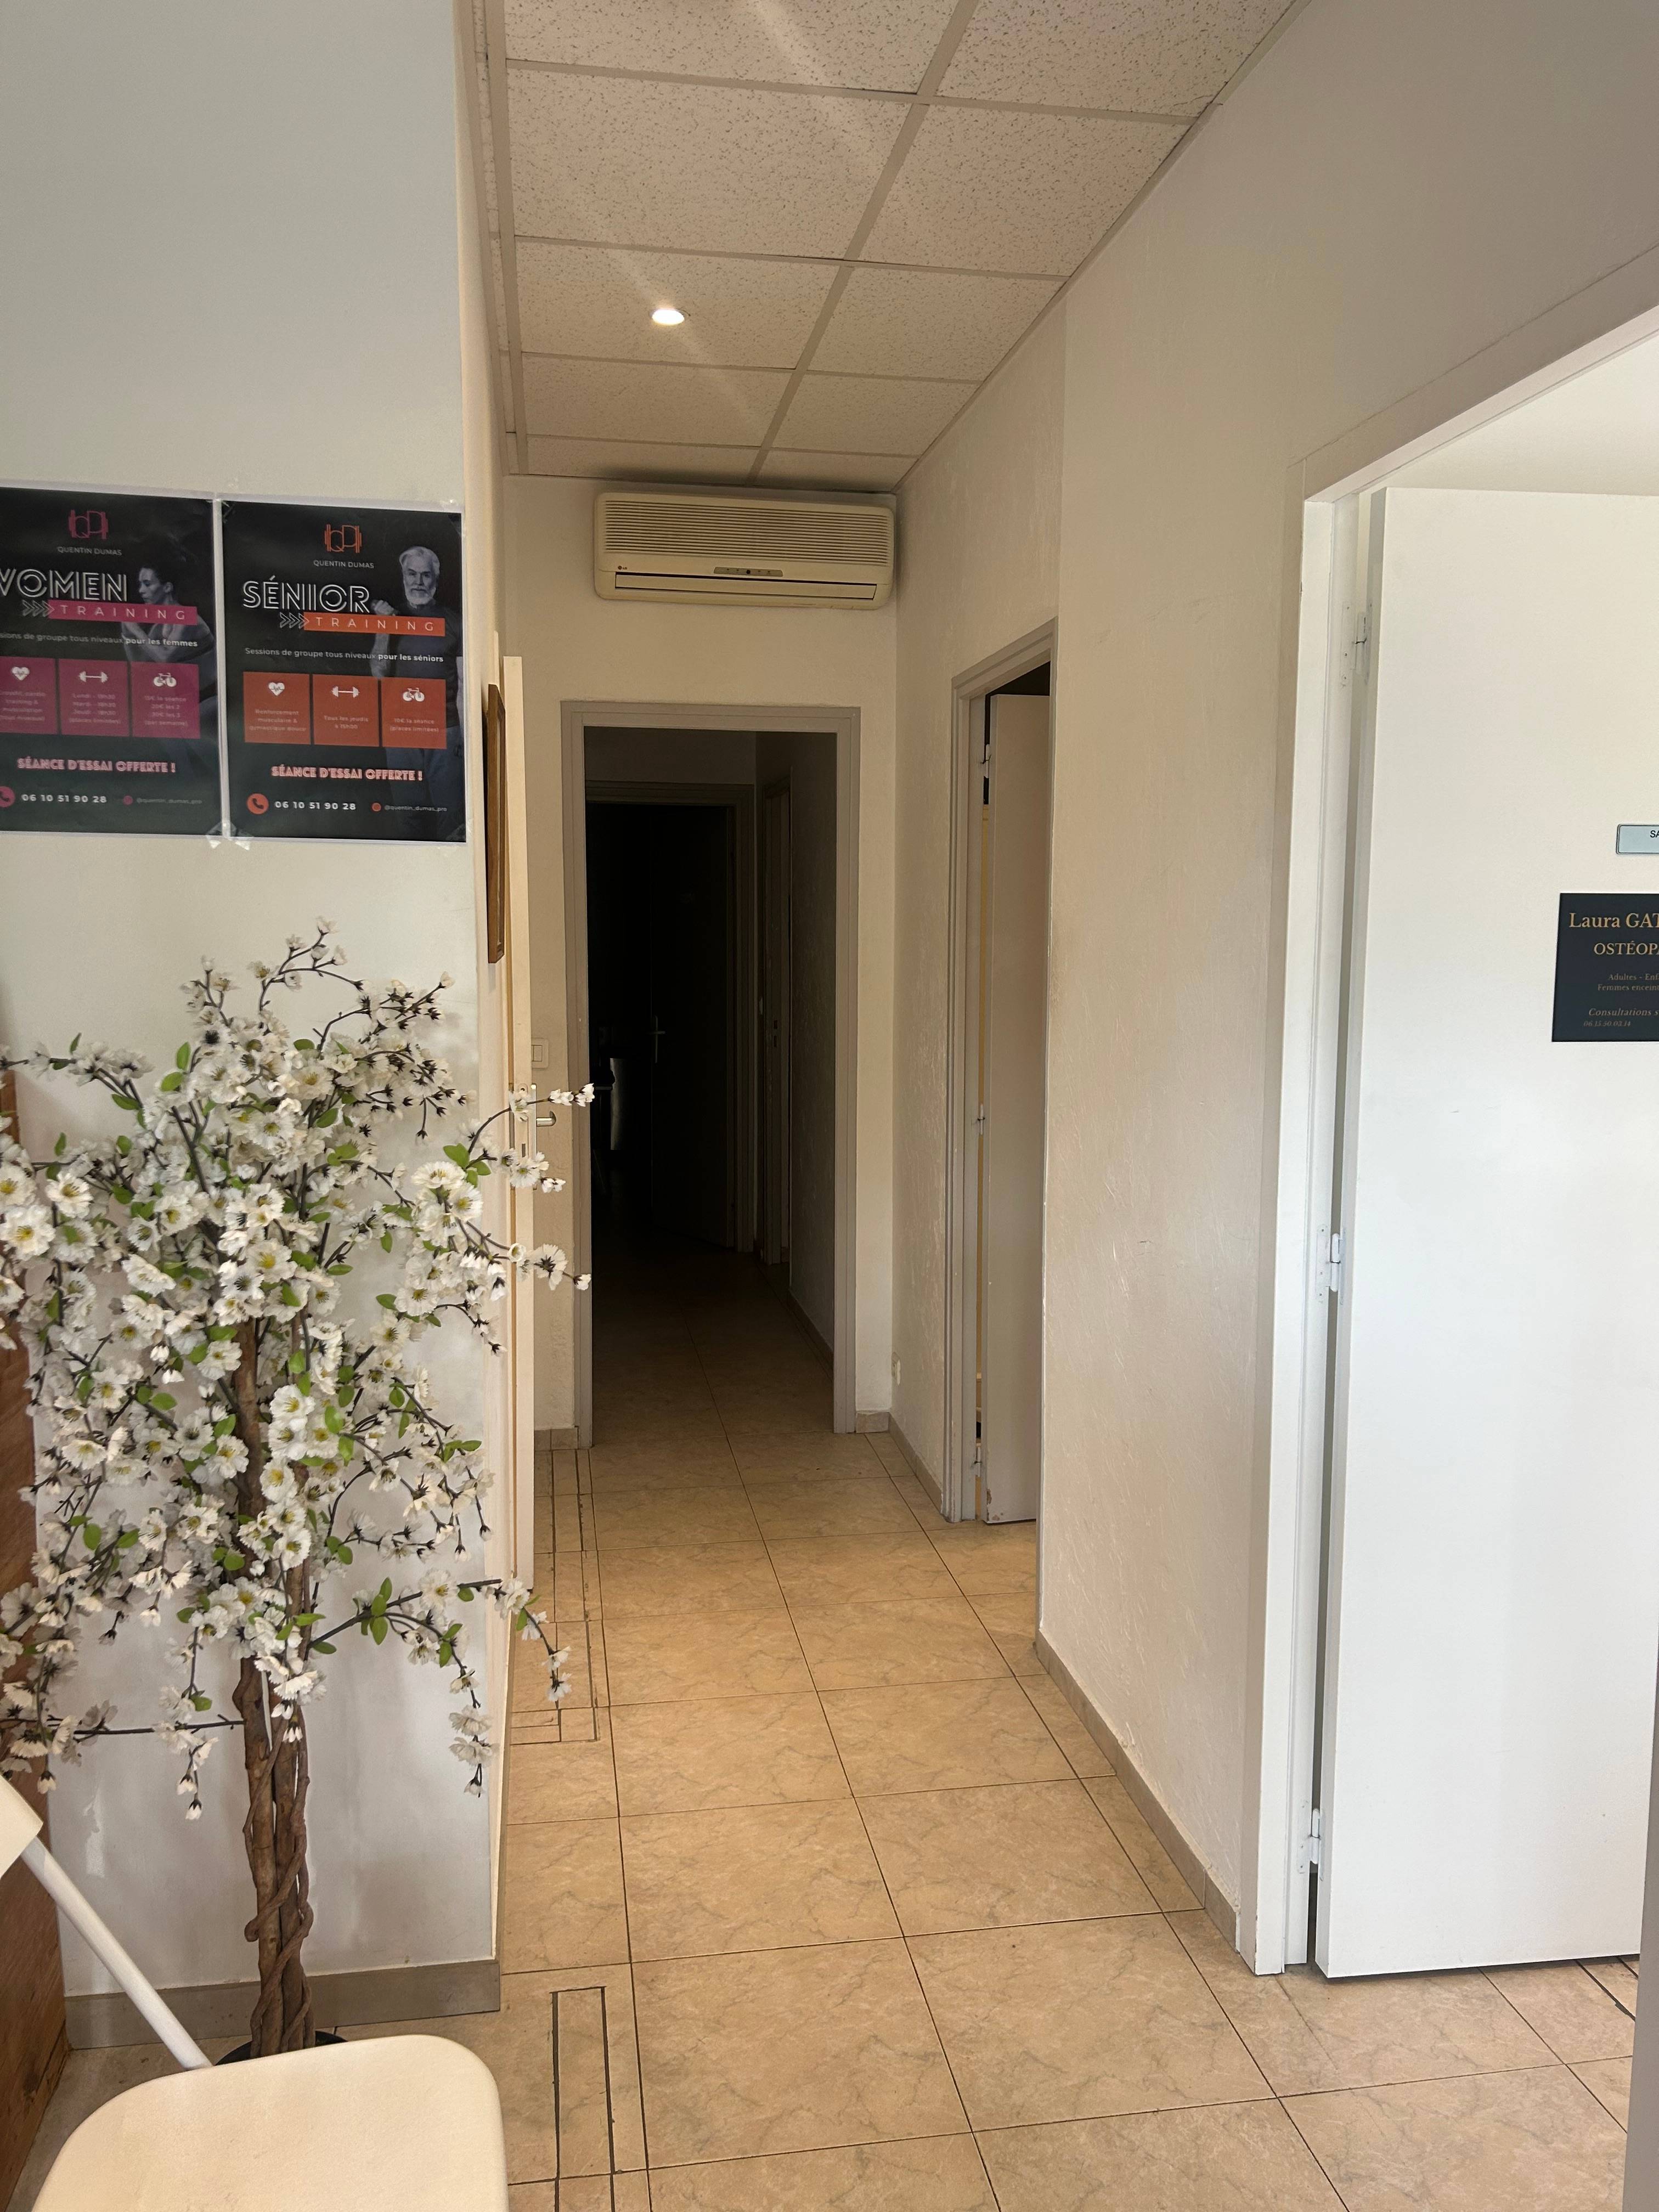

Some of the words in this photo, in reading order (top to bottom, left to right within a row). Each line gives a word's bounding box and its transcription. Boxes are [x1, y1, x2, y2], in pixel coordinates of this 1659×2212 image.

[58, 546, 92, 555] QUENTIN
[314, 560, 346, 568] QUENTIN
[243, 575, 370, 613] SÉNIOR
[61, 605, 186, 619] TRAINING
[317, 618, 433, 631] TRAINING
[37, 634, 67, 643] groupe
[126, 637, 146, 646] pour
[163, 639, 198, 647] femmes
[245, 647, 279, 656] Sessions
[294, 650, 323, 658] groupe
[379, 654, 397, 662] pour
[414, 654, 443, 663] séniors
[18, 756, 65, 770] SÉANCE
[68, 759, 112, 771] D'ESSAI
[116, 761, 168, 772] OFFERTE
[171, 763, 176, 772] !
[272, 764, 316, 777] SÉANCE
[320, 768, 363, 779] D'ESSAI
[365, 769, 415, 781] OFFERTE
[419, 771, 423, 781] !
[275, 801, 289, 809] 06
[325, 802, 338, 810] 90
[343, 803, 356, 811] 28
[1569, 912, 1620, 928] Laura
[1594, 940, 1659, 956] OSTÉOP
[1589, 1008, 1651, 1016] Consultations
